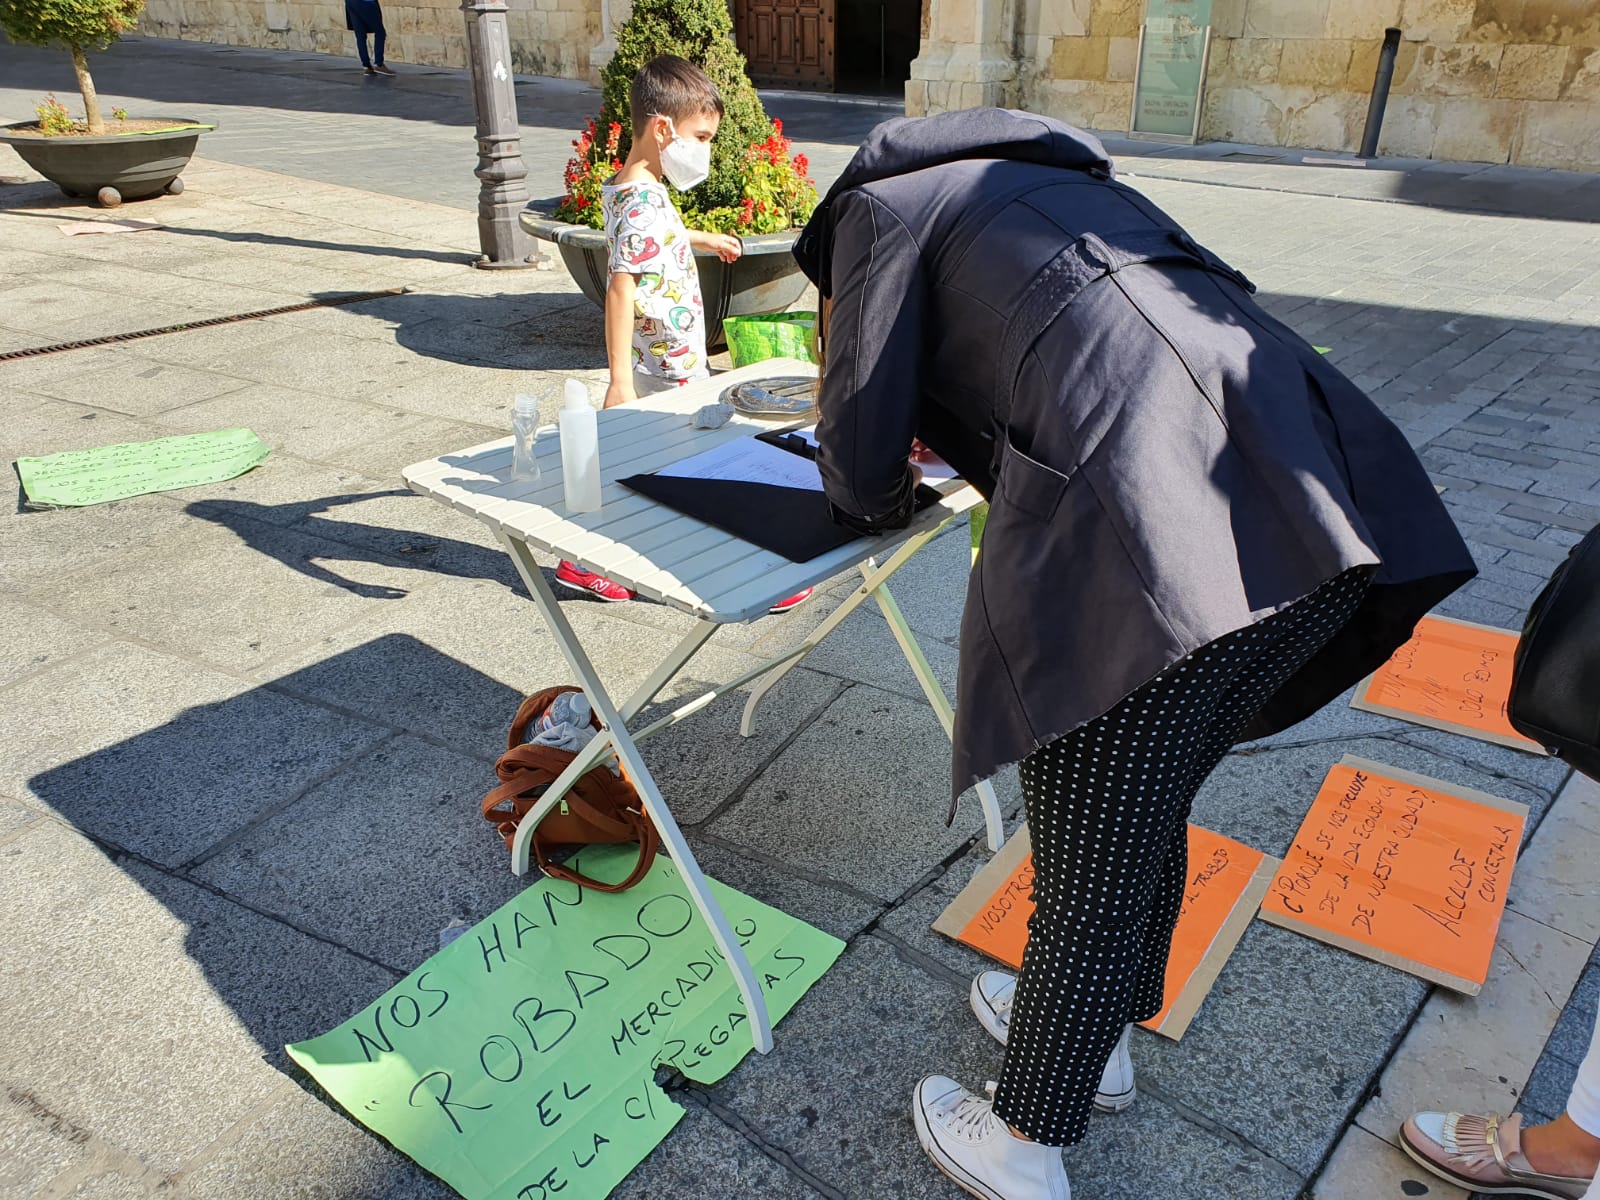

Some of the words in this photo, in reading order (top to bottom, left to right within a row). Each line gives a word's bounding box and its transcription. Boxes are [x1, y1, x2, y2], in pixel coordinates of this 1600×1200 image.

[1412, 847, 1477, 938] ALCALDE
[1351, 903, 1376, 936] DE
[352, 972, 449, 1062] NOS
[478, 858, 583, 973] HAN
[536, 1081, 592, 1127] EL
[573, 1133, 610, 1168] LA
